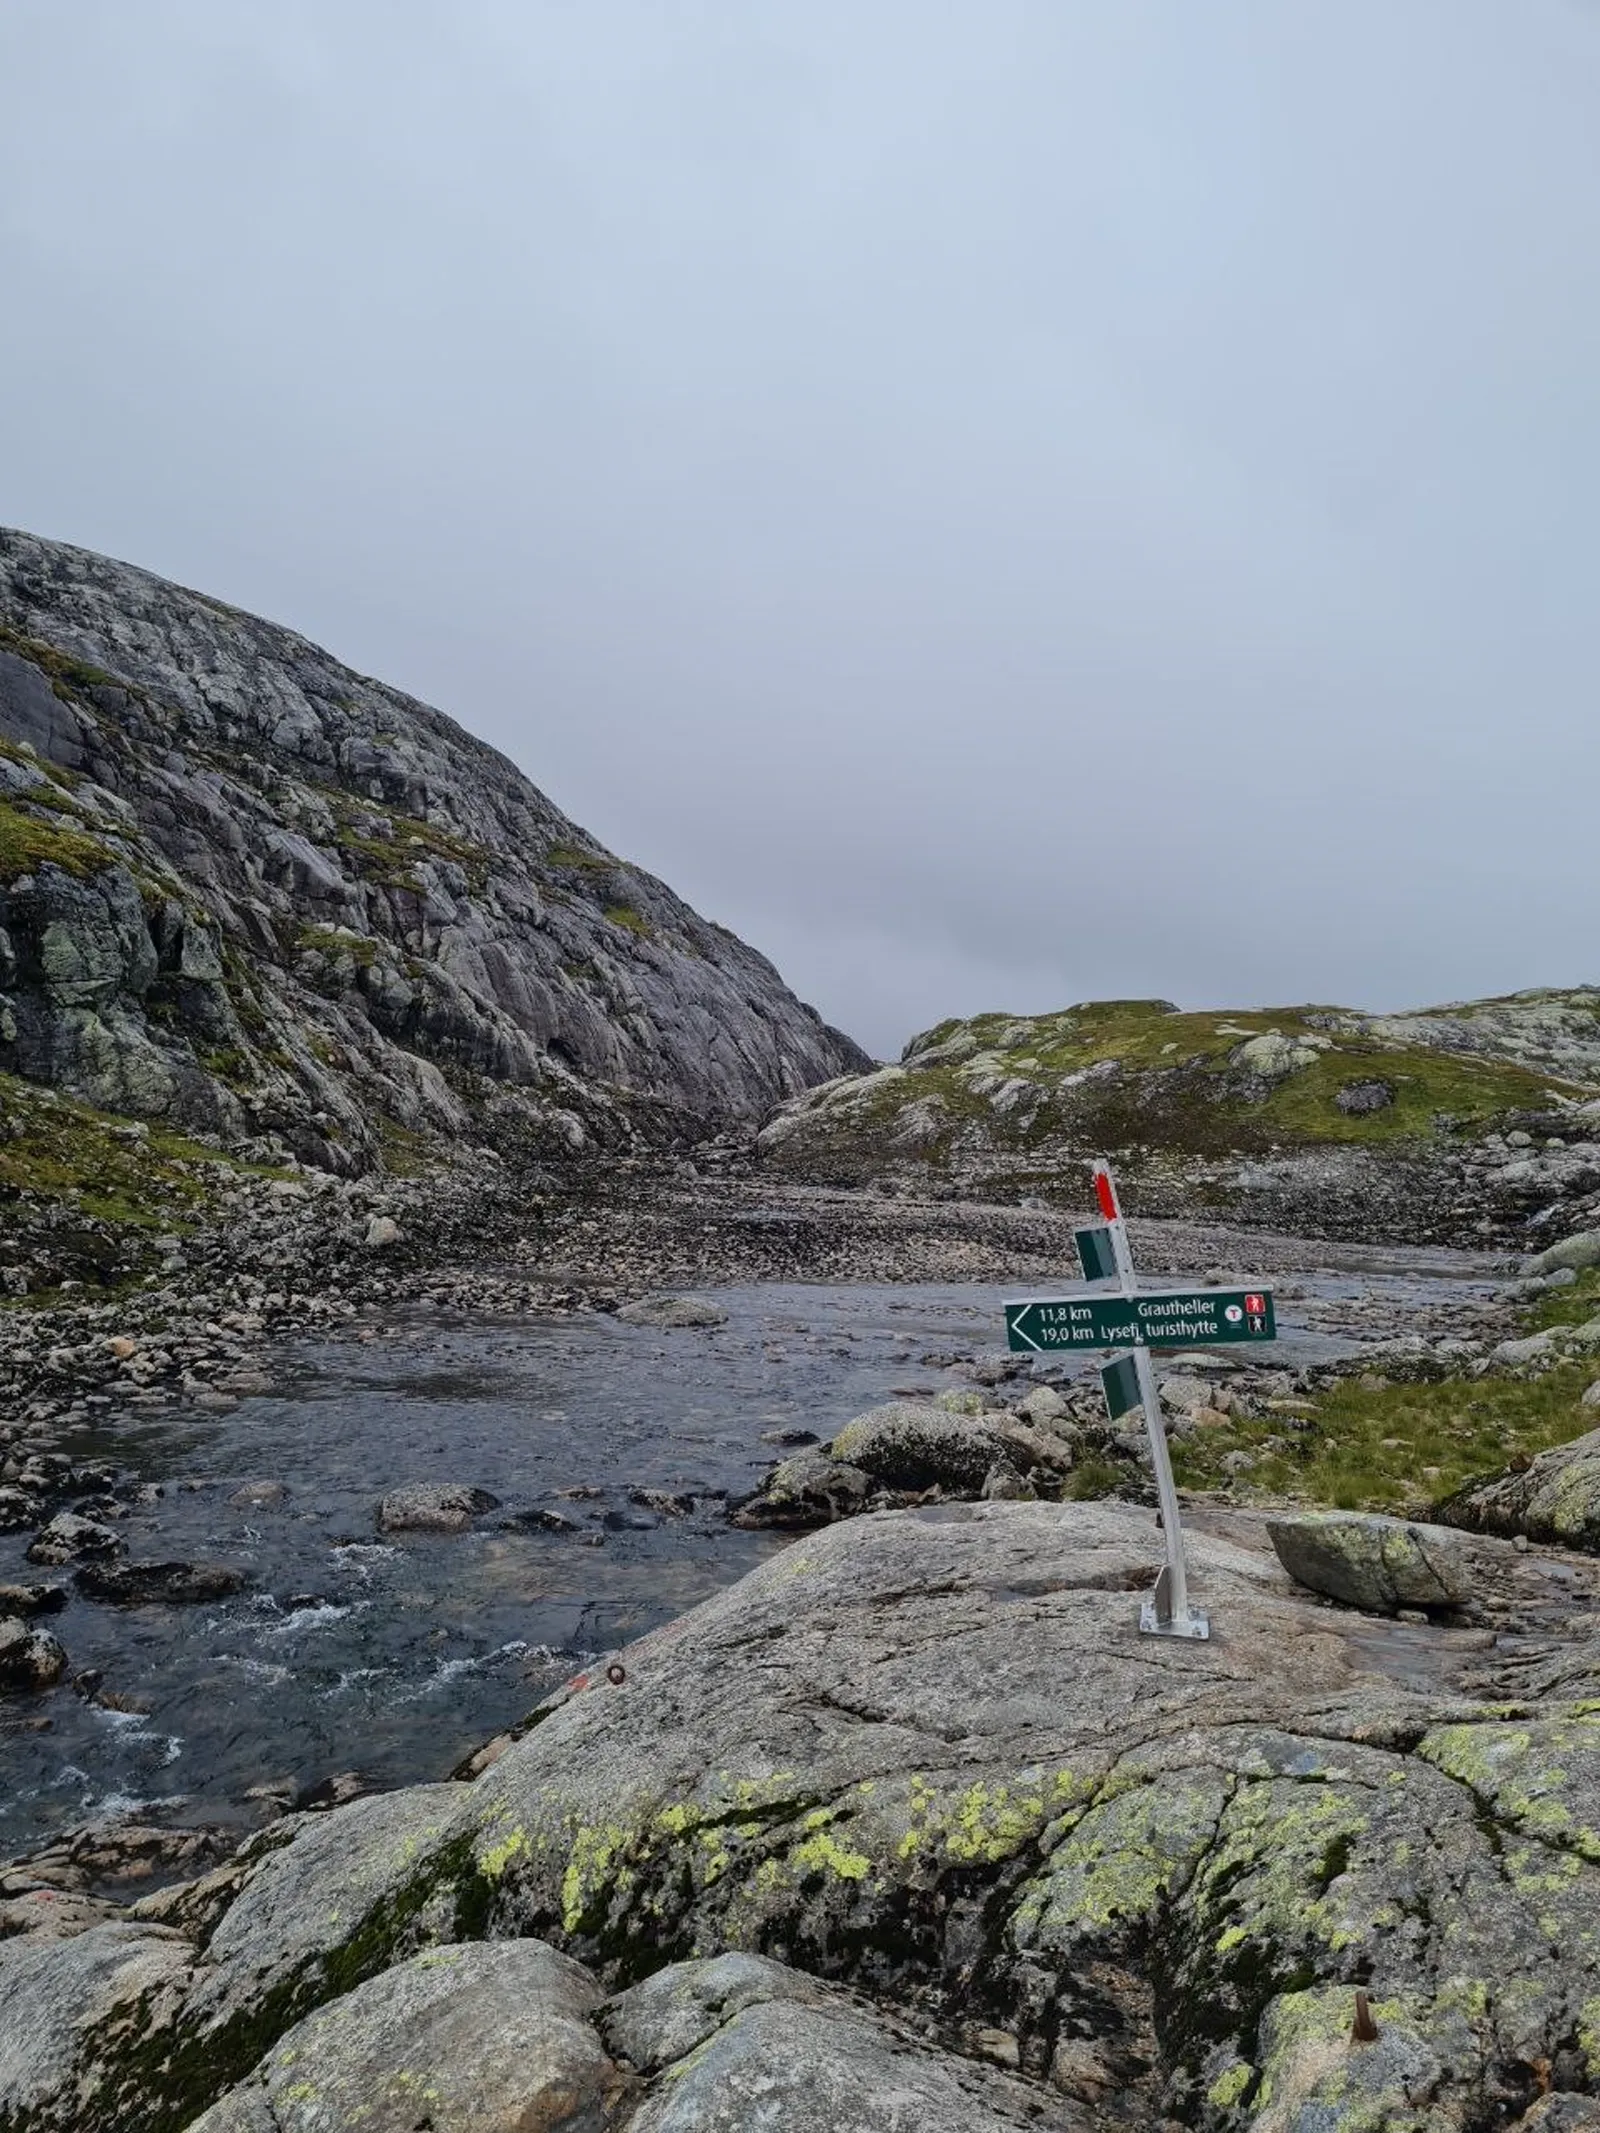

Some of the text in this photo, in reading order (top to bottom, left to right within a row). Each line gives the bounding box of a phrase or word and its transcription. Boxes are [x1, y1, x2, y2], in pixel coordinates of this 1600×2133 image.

[1039, 1299, 1216, 1324] 11,8 km Grautheller
[1041, 1328, 1069, 1344] 19,0
[1072, 1326, 1094, 1341] km
[1145, 1320, 1219, 1339] turisthytte
